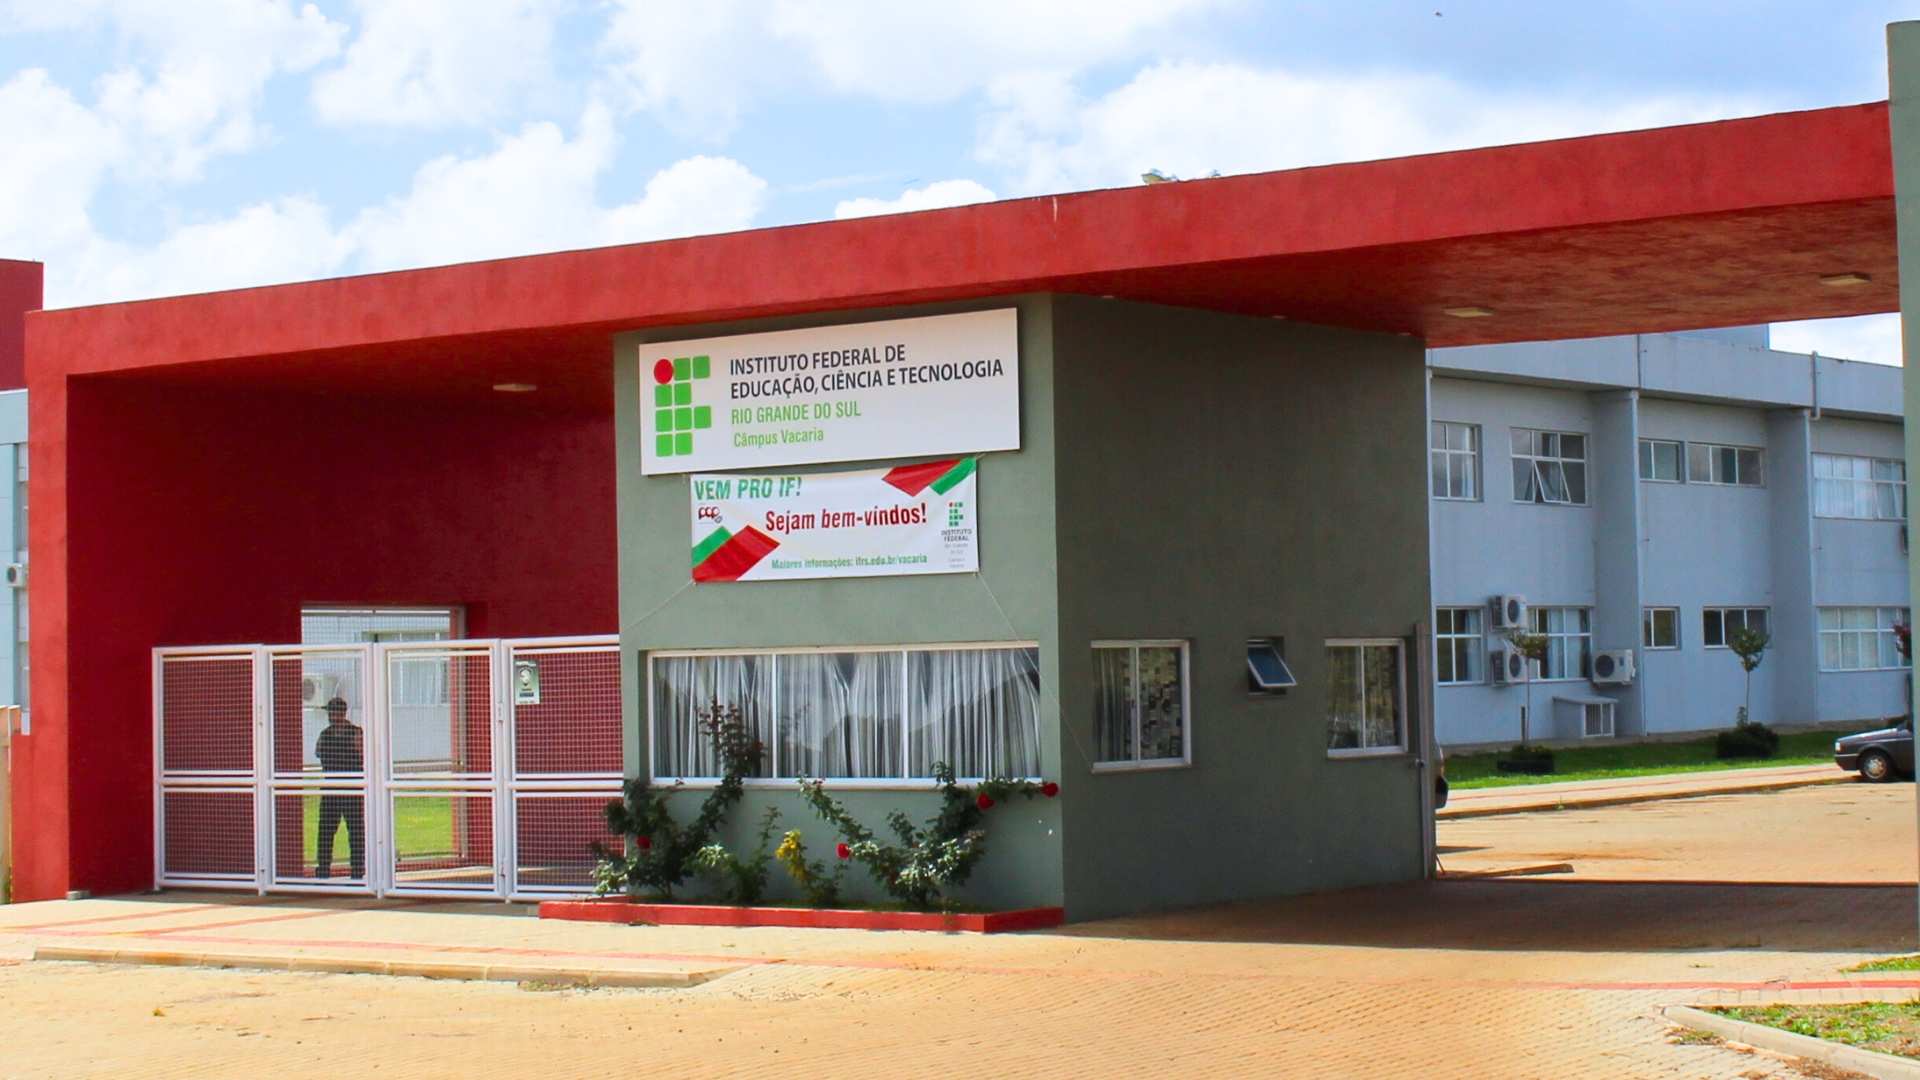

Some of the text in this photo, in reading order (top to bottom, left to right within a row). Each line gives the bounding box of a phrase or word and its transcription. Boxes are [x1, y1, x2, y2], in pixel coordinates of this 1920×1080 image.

[730, 344, 906, 376] INSTITUTO FEDERAL DE
[731, 359, 1004, 399] EDUCAÇÃO, CIÊNCIA E TECNOLOGIA
[731, 401, 862, 425] RIO GRANDE DO SUL
[733, 427, 824, 449] Câmpus Vacaria
[694, 476, 802, 500] VEM PRO IF!
[765, 502, 927, 535] Sejam bem-vindos!
[771, 559, 803, 569] Maiores
[804, 557, 853, 569] informações:
